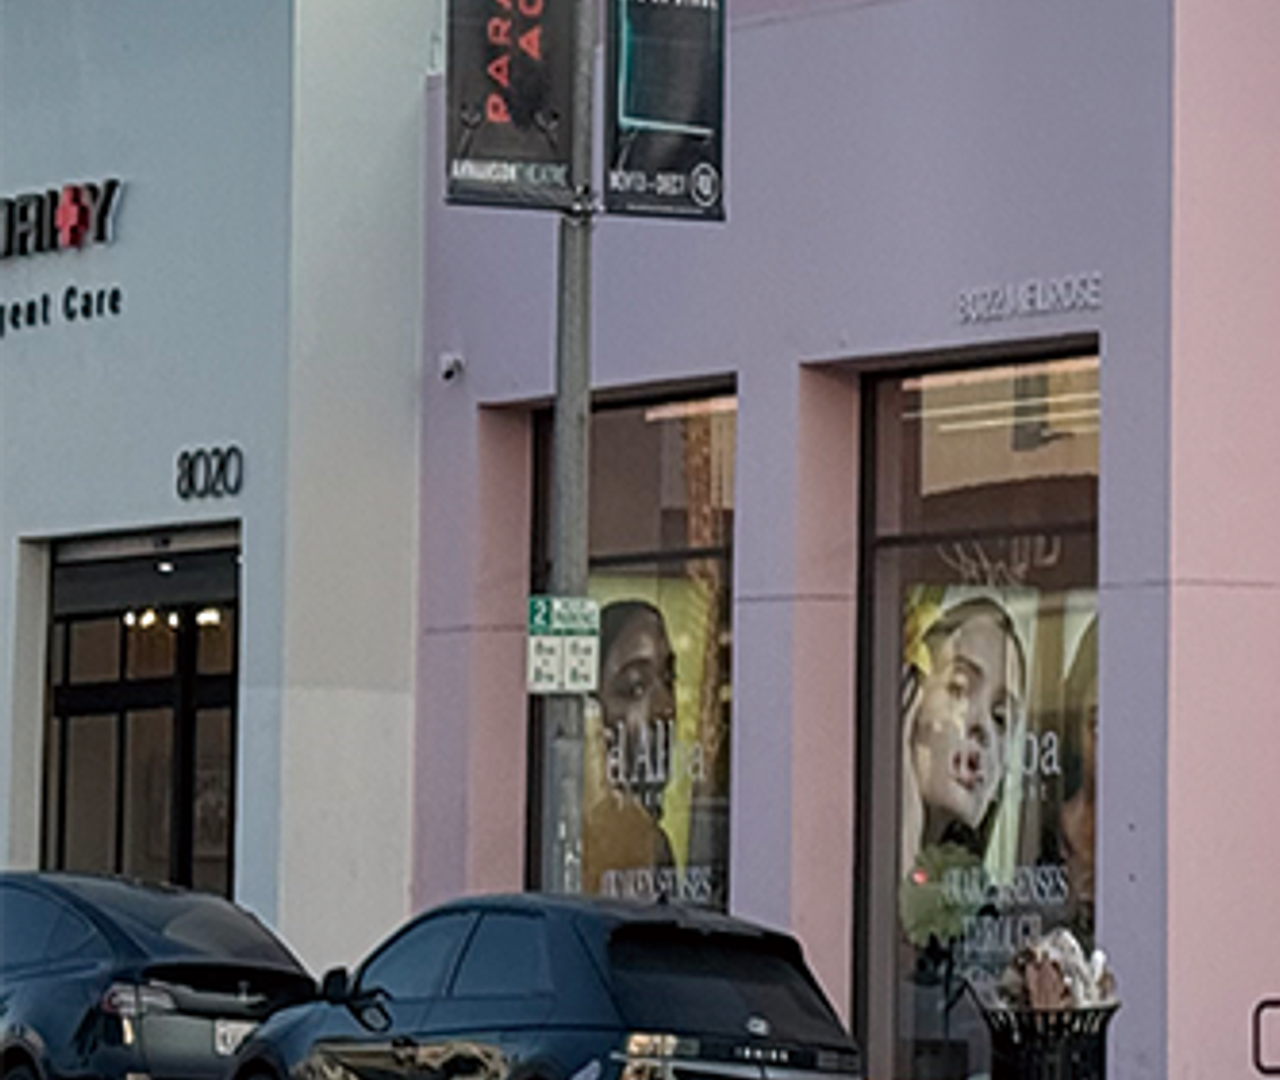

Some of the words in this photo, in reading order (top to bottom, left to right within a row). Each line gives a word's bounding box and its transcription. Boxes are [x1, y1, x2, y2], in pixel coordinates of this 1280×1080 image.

[63, 284, 122, 322] Care
[176, 444, 244, 501] 8020
[533, 600, 548, 626] 2
